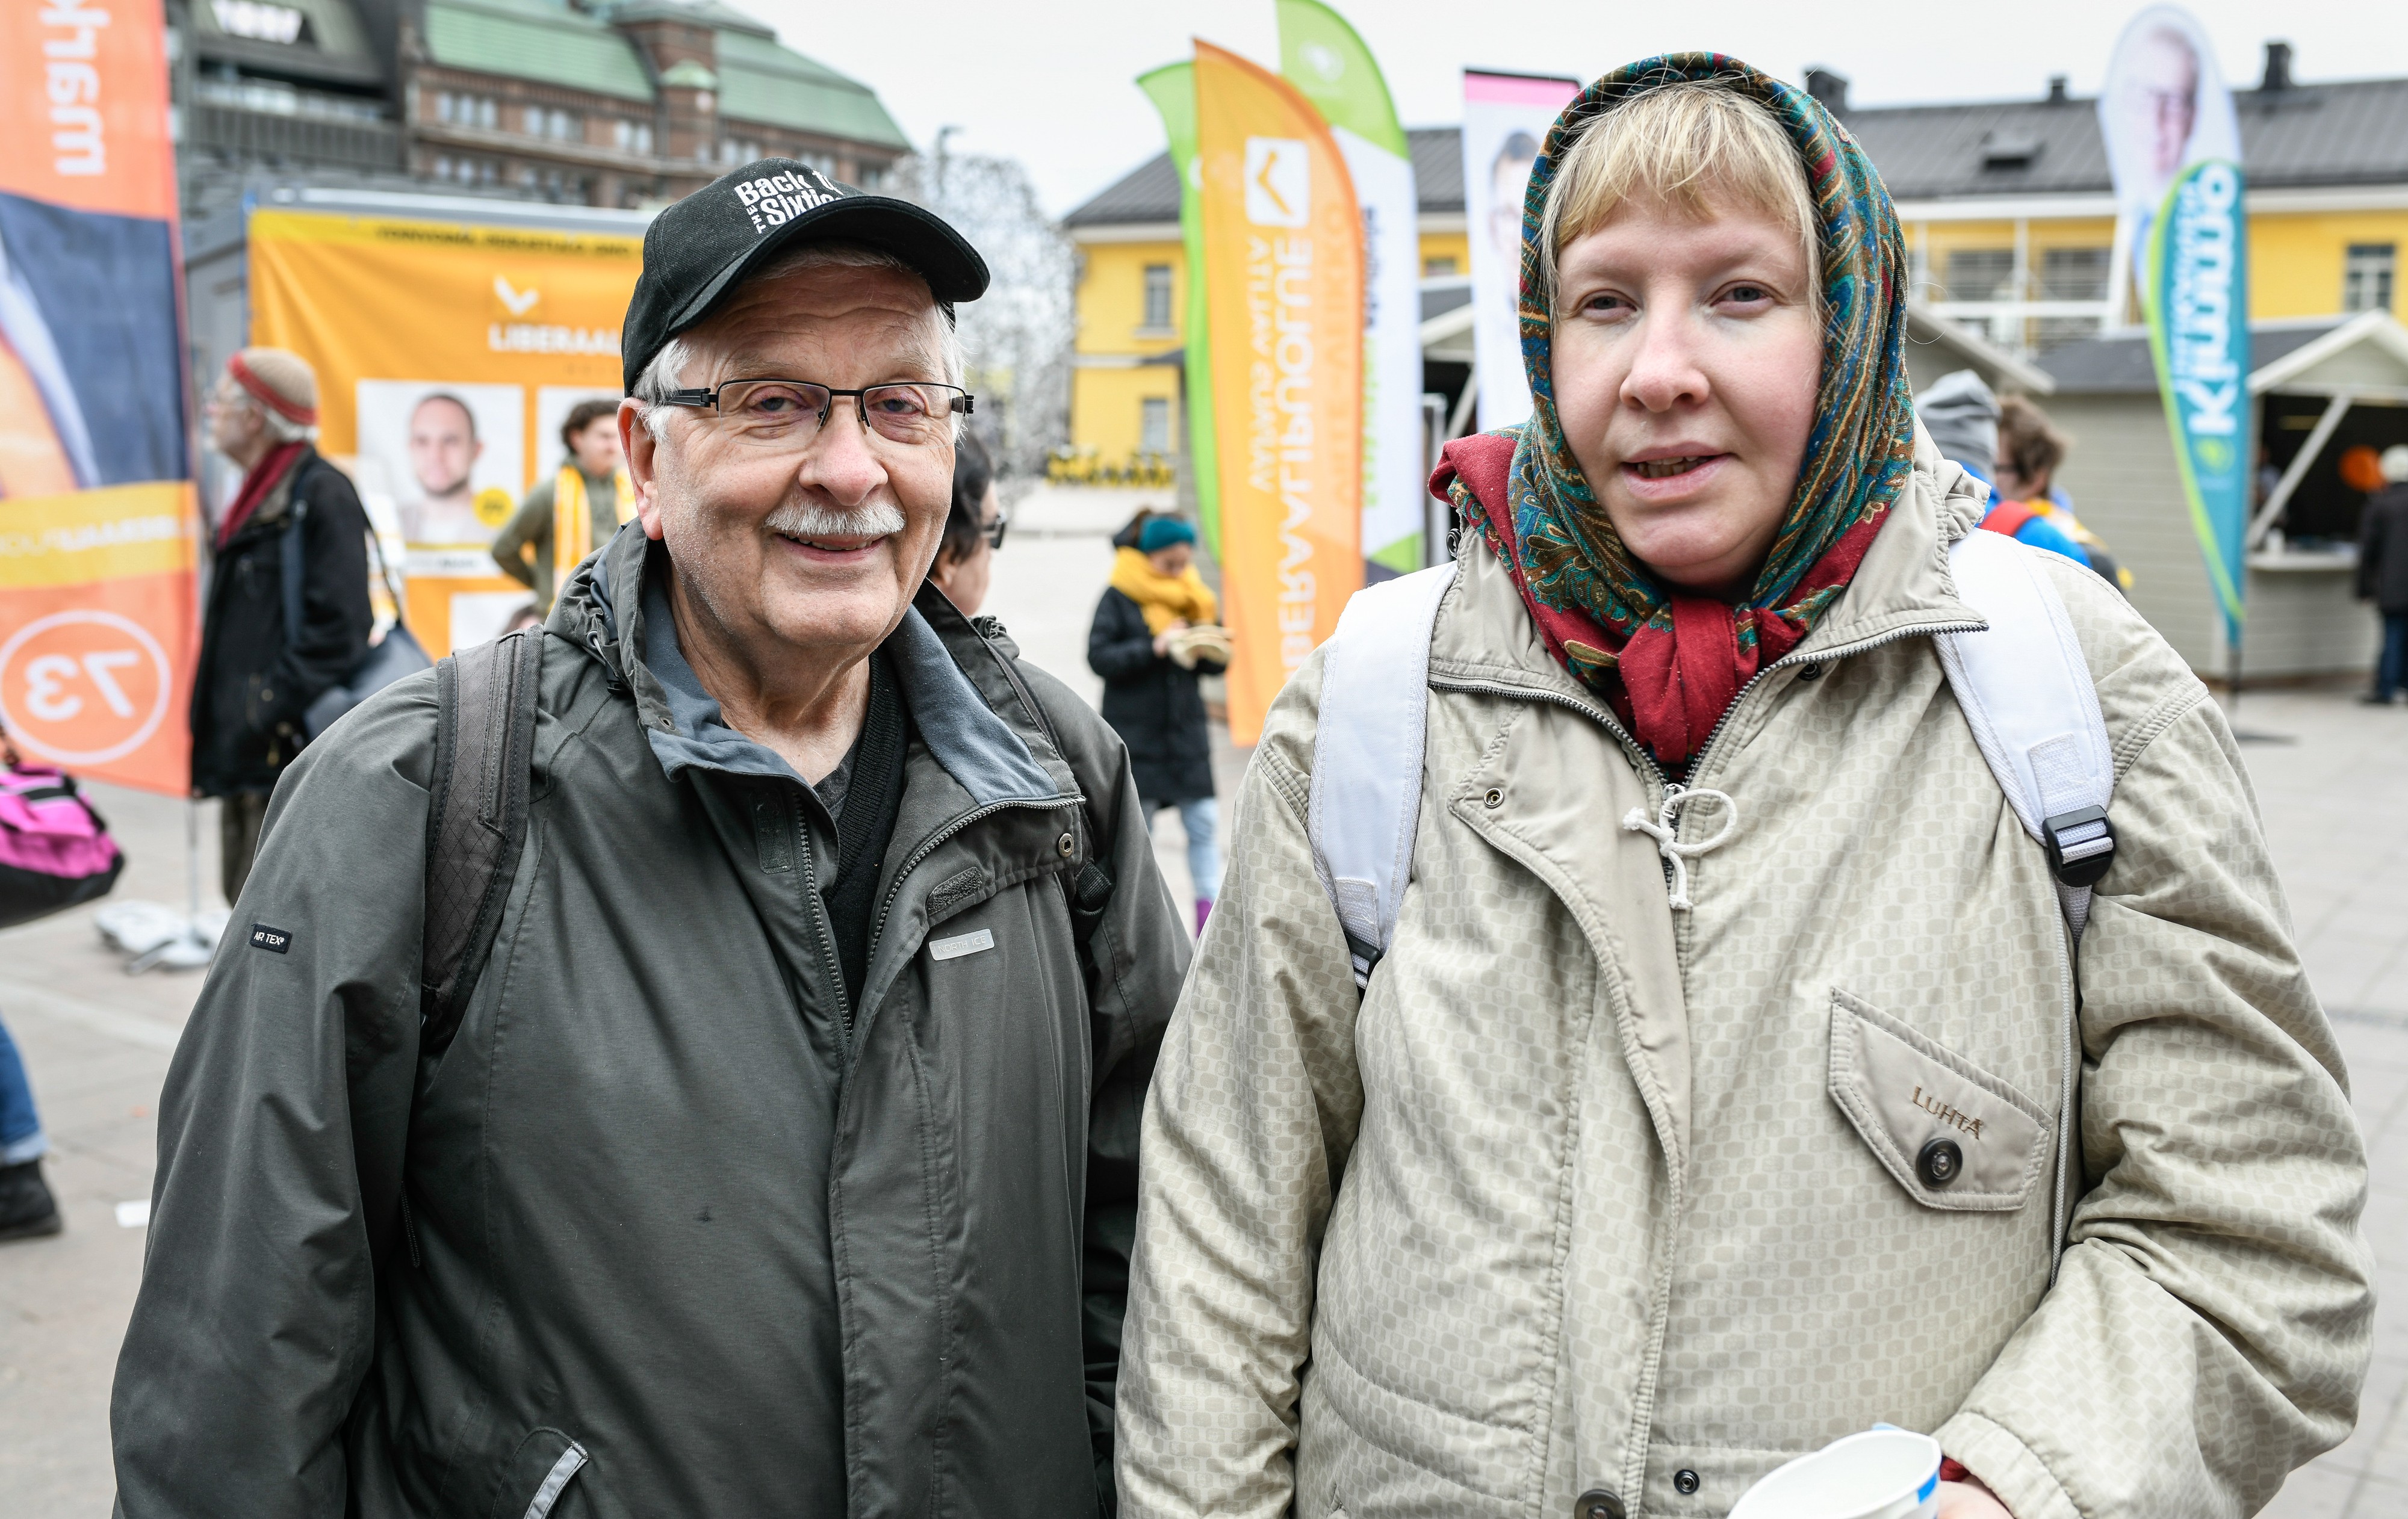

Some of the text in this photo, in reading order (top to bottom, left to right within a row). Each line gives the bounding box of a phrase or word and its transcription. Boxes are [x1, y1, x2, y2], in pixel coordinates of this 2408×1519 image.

[734, 170, 813, 206] Back
[746, 205, 766, 234] THE
[760, 189, 843, 226] Sixti
[938, 935, 985, 953] NORTH ICE
[1913, 1085, 1983, 1140] LUHTA
